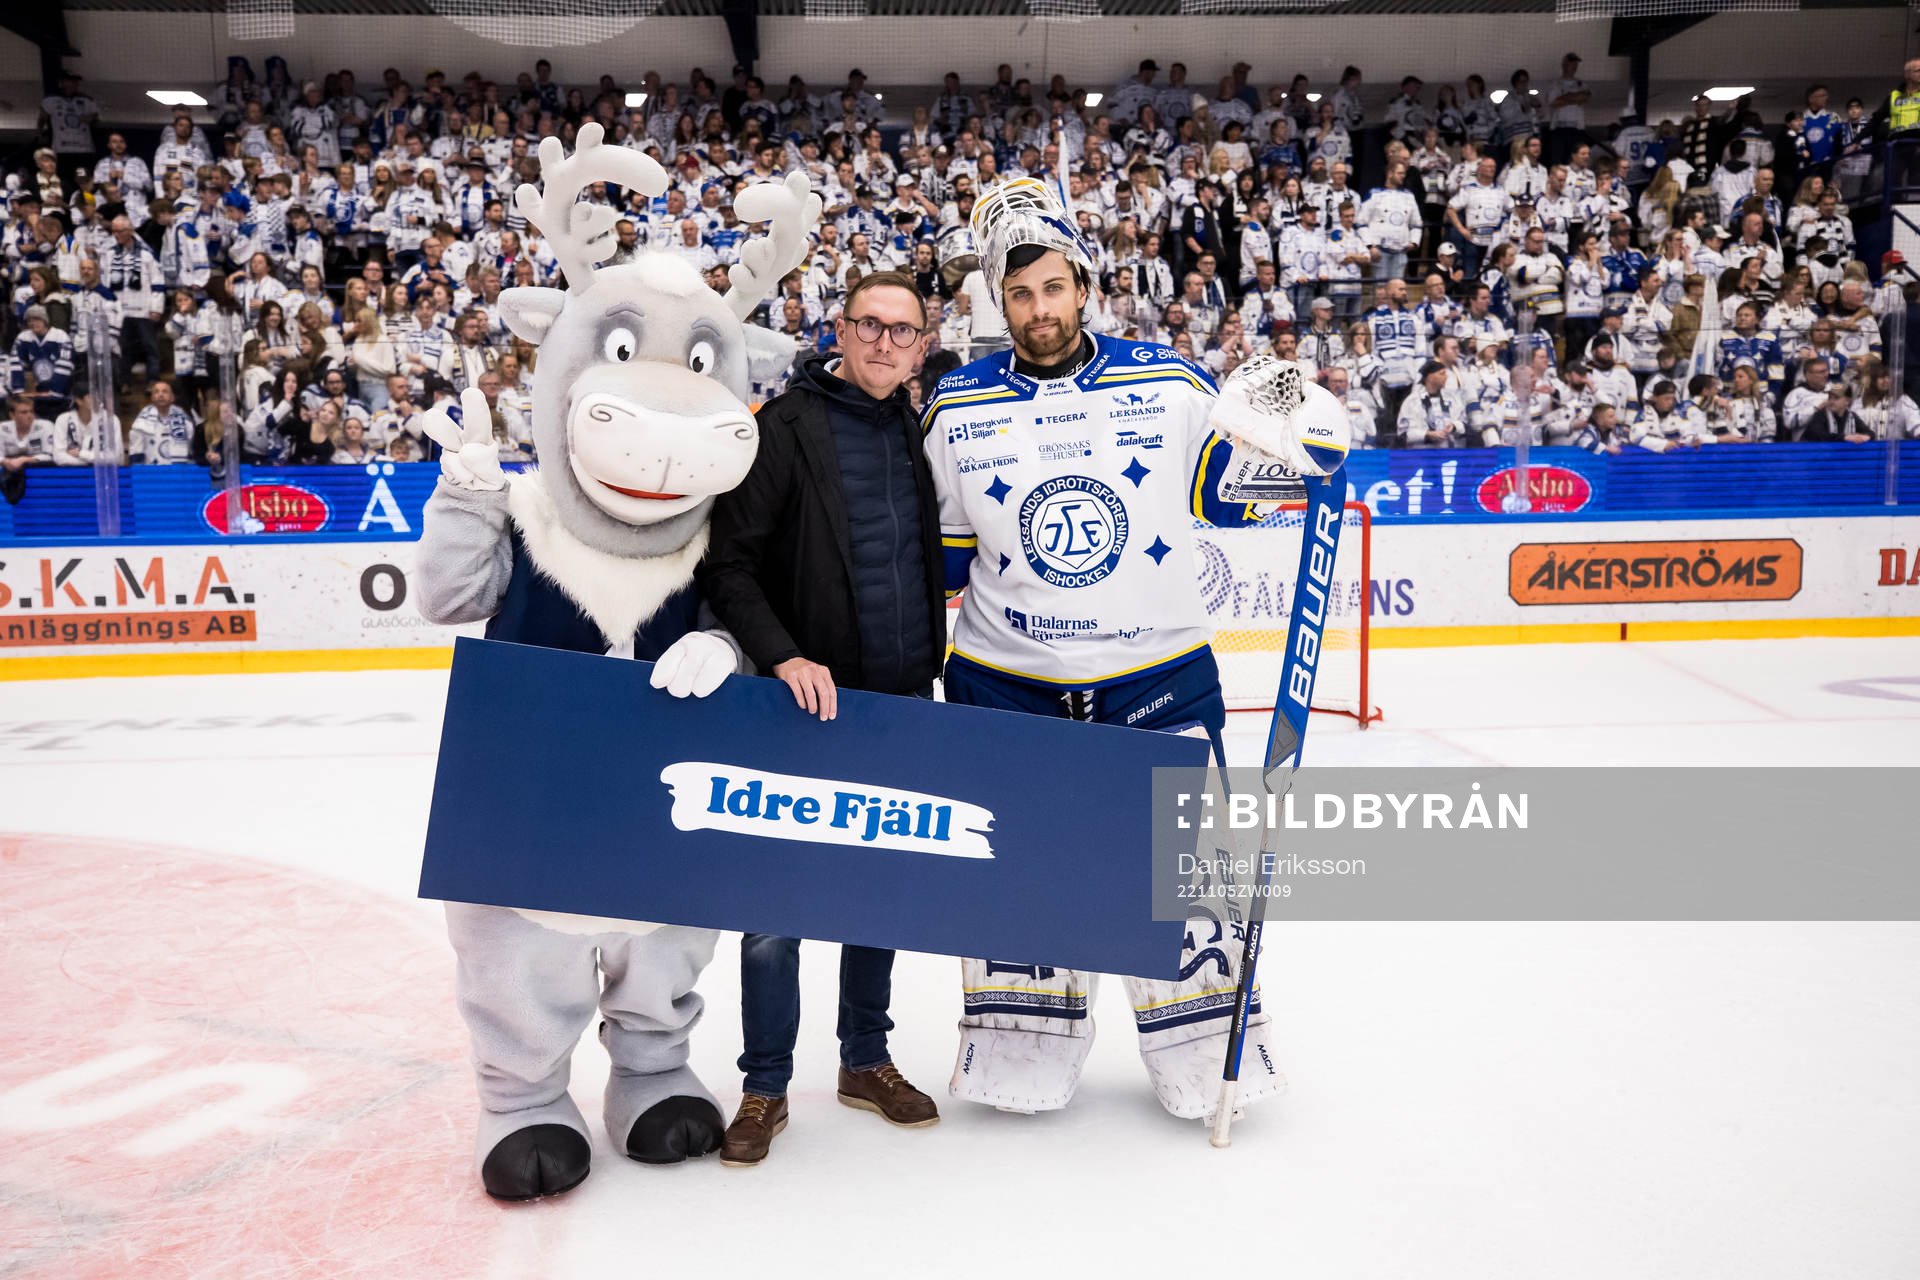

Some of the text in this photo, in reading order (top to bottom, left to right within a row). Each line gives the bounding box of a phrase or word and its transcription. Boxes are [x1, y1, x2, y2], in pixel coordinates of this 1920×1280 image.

[1087, 354, 1110, 378] TEGERA
[938, 377, 979, 389] Ohlson
[1046, 381, 1067, 390] SHL
[969, 416, 1012, 430] Bergkvist
[1046, 412, 1087, 424] TEGERA
[1109, 406, 1166, 418] LEKSANDS
[971, 428, 996, 440] Siljan
[1116, 433, 1163, 447] dalakraft
[1307, 426, 1333, 437] MACH
[1038, 440, 1091, 453] GRÖNSAKS
[1053, 449, 1084, 460] HUSET
[960, 457, 1018, 474] AB KARL HEDIN
[1228, 460, 1252, 502] BAUER
[1346, 459, 1458, 516] et!
[358, 463, 411, 532] Ä
[1020, 477, 1127, 564] LEKSANDS IDROTTSFÖRENING
[0, 556, 255, 608] .K.M.A.
[1043, 562, 1111, 587] ISHOCKEY
[1528, 549, 1782, 591] ÅKERSTRÖMS
[1289, 502, 1340, 709] BAUER
[0, 615, 247, 642] nläggnings AB
[1032, 616, 1098, 630] Dalarnas
[1127, 692, 1174, 725] BAUER
[707, 776, 952, 842] Idre Fjäll
[1248, 924, 1260, 961] MACH
[963, 1042, 975, 1075] MACH
[1256, 1043, 1276, 1076] MACH
